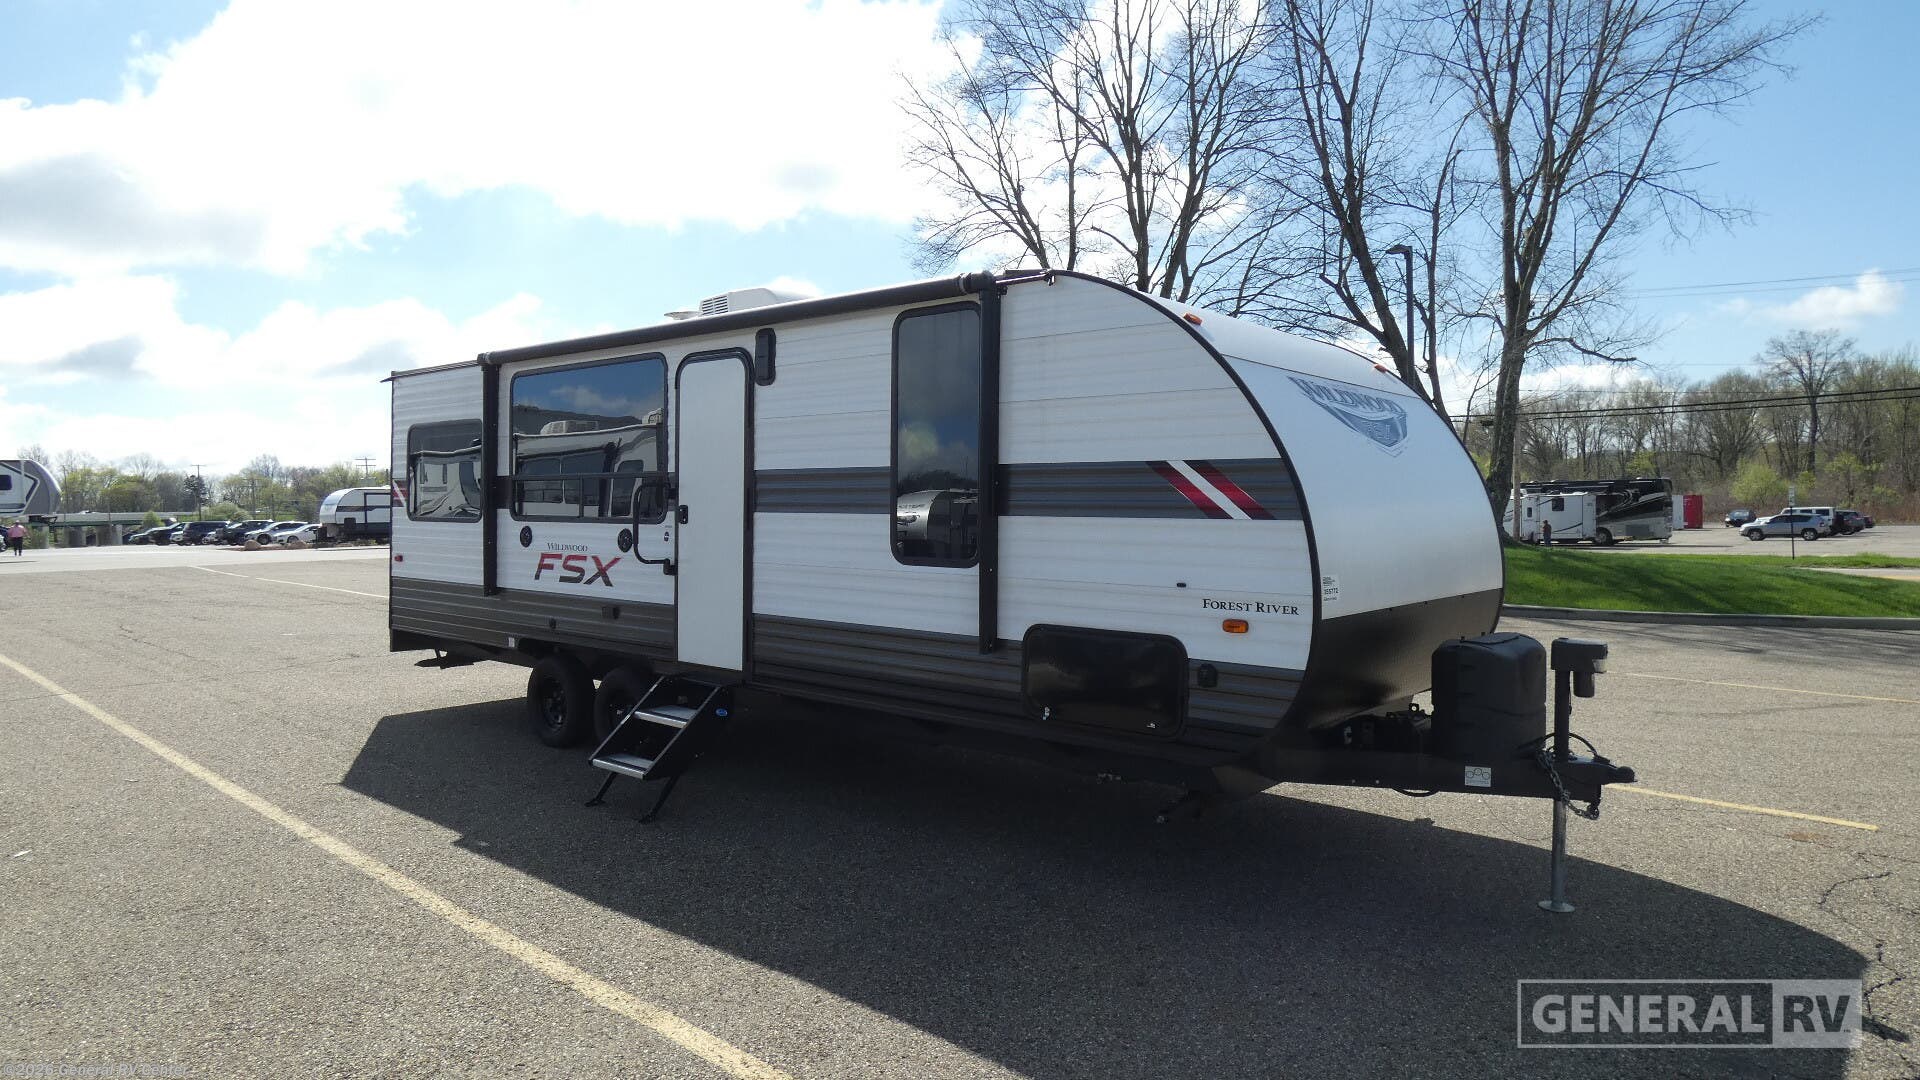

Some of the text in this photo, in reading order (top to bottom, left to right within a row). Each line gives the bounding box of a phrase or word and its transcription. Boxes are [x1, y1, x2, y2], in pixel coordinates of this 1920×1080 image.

[547, 543, 588, 552] WILDWOOD
[534, 552, 621, 587] FSX
[1202, 598, 1299, 615] FOREST RIVER
